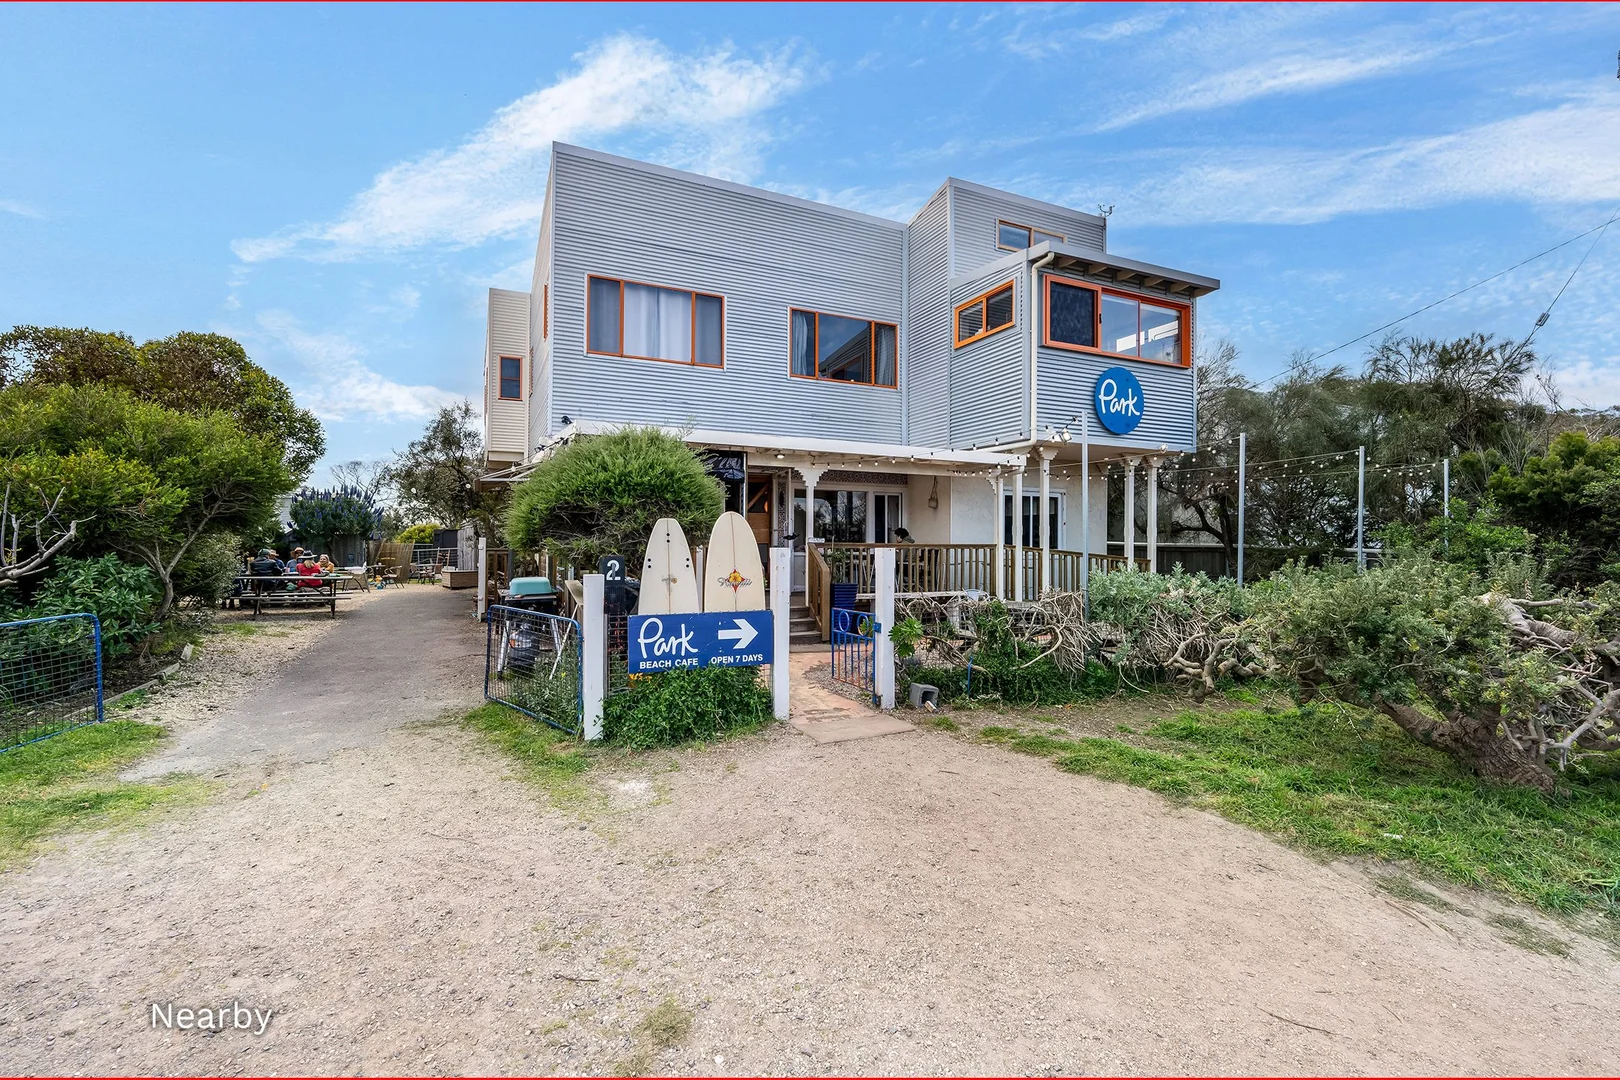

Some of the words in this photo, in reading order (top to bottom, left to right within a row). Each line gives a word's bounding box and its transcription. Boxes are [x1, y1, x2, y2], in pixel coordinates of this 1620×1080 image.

[1098, 379, 1140, 417] Park
[607, 560, 621, 580] 2
[638, 617, 698, 658] Park
[639, 660, 672, 669] BEACH
[675, 658, 699, 667] CAFE
[710, 656, 734, 664] OPEN
[742, 654, 763, 662] DAYS
